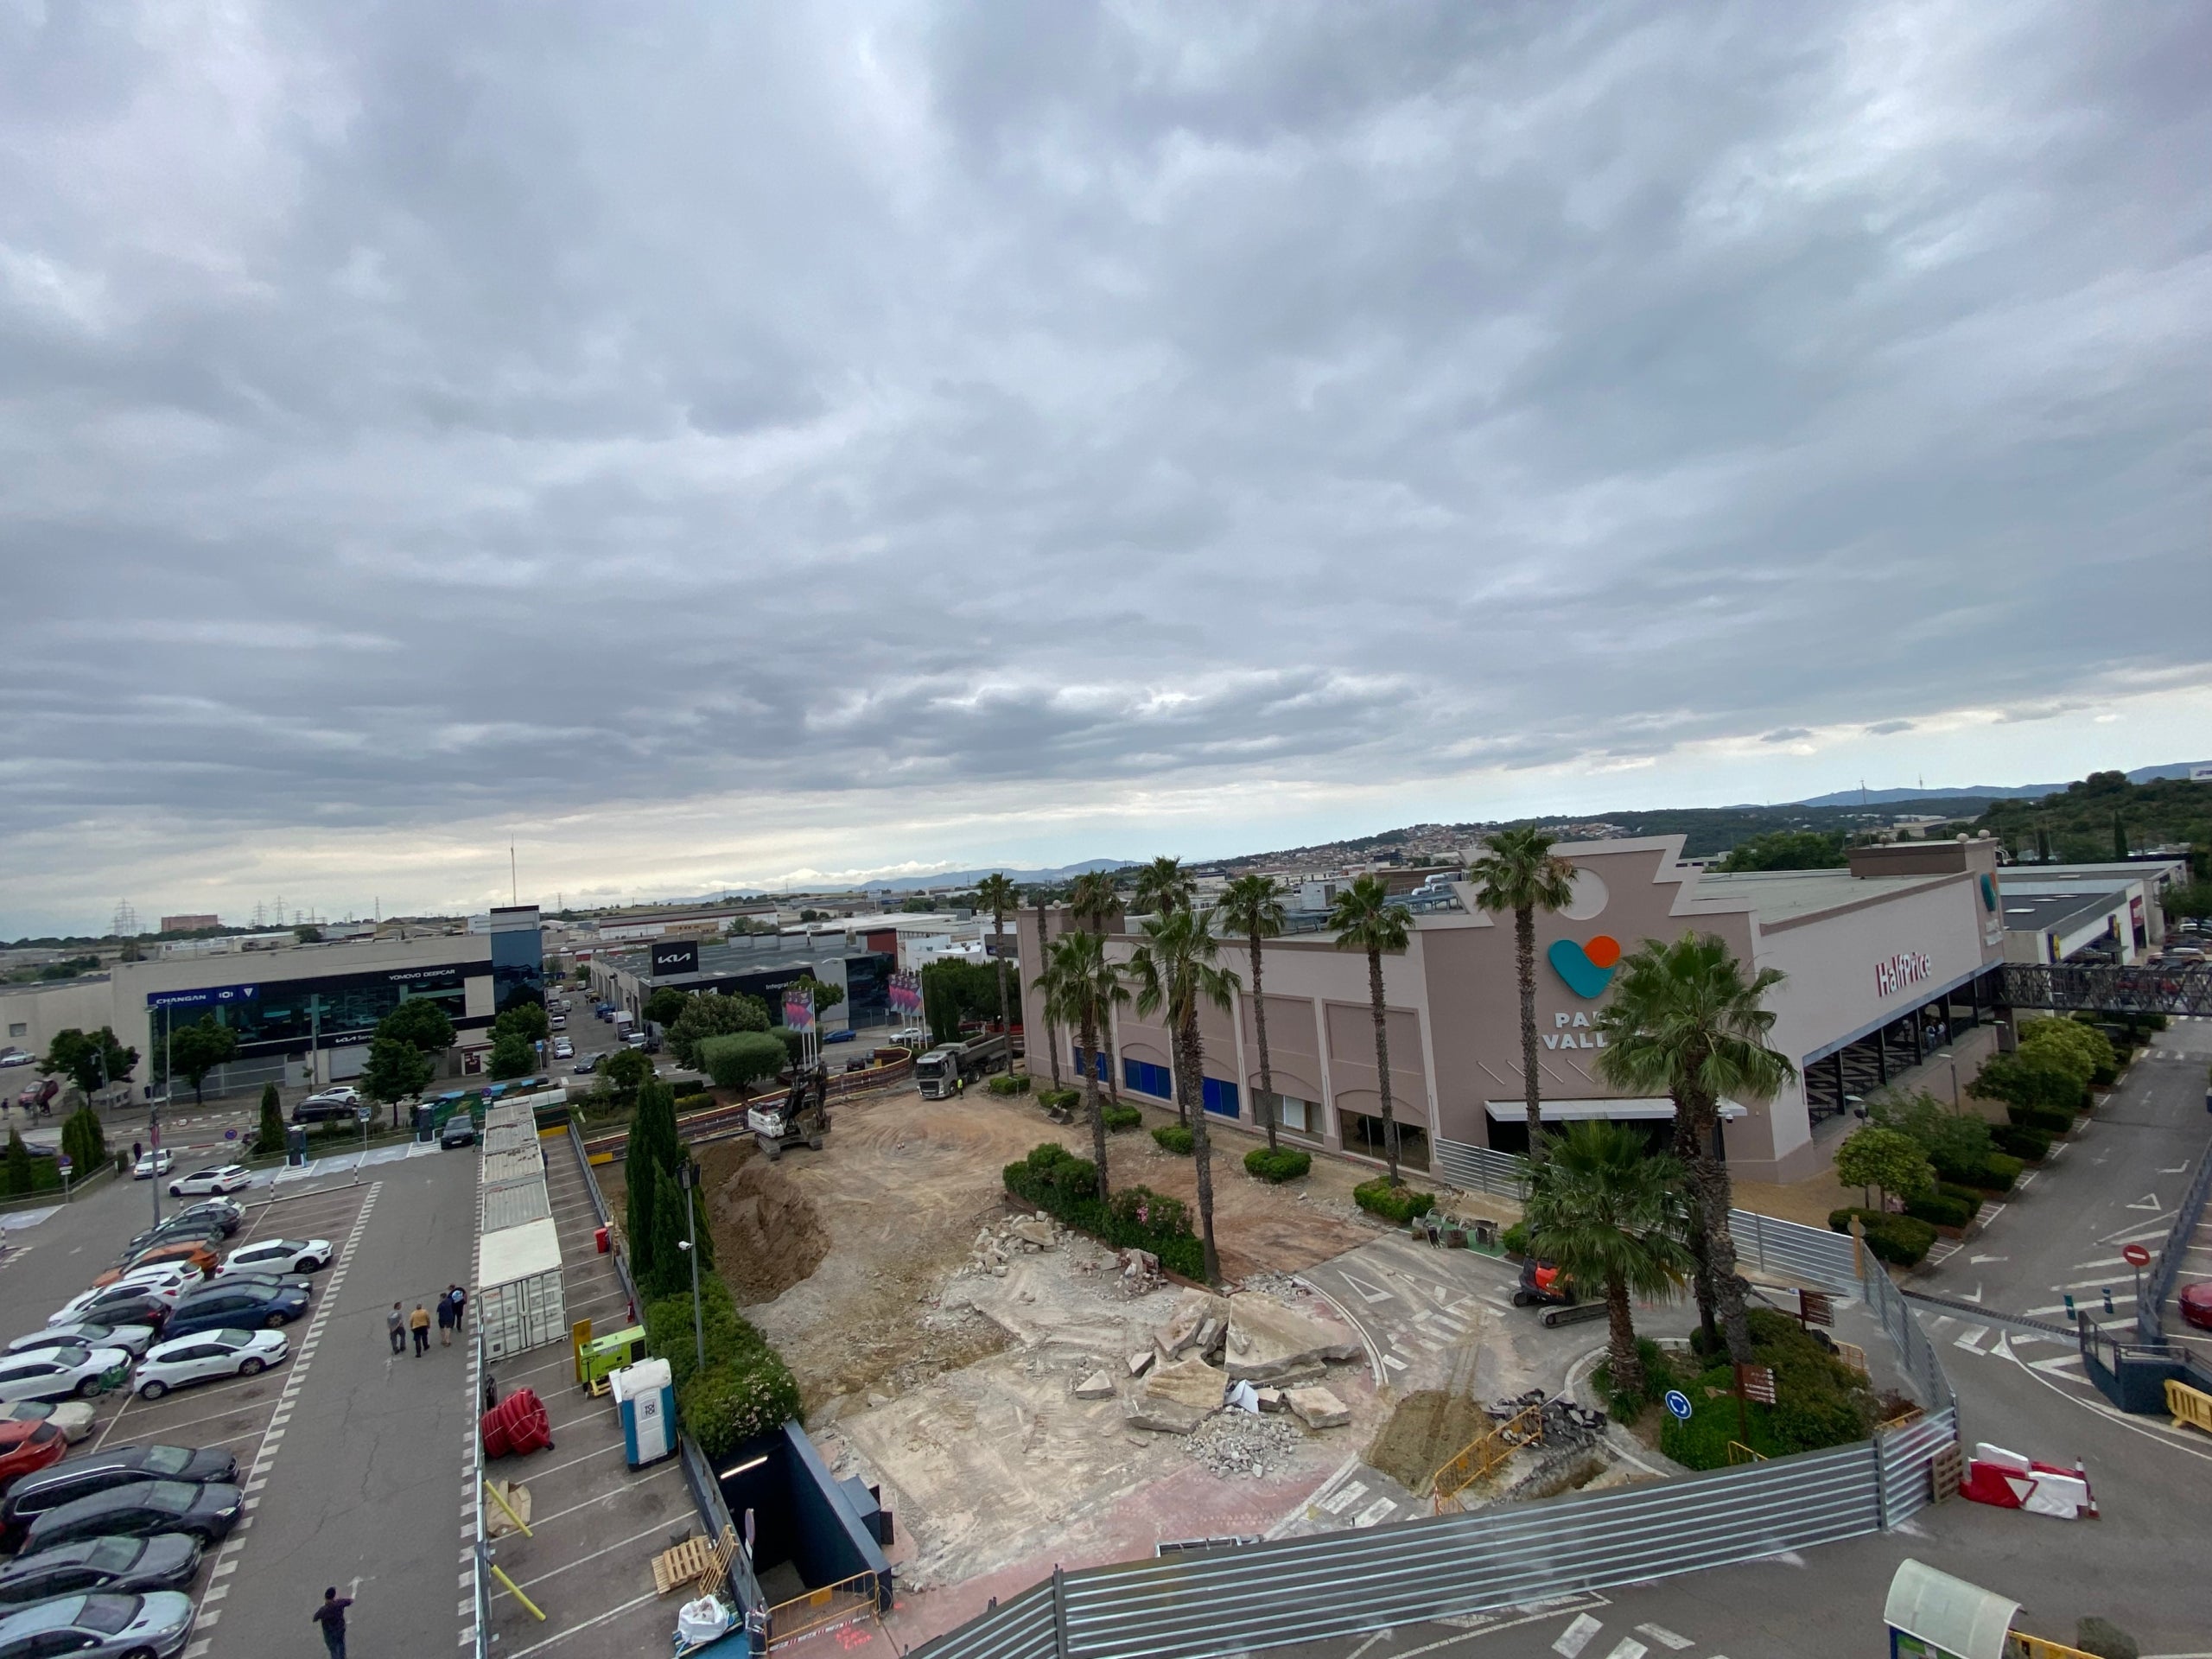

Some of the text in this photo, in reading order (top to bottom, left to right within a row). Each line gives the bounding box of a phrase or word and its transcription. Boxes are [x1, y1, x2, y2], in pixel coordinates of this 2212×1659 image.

[658, 952, 691, 964] KIA
[1875, 951, 1931, 997] HalfPrice
[765, 981, 789, 991] Integral
[156, 994, 207, 1005] CHANGAN
